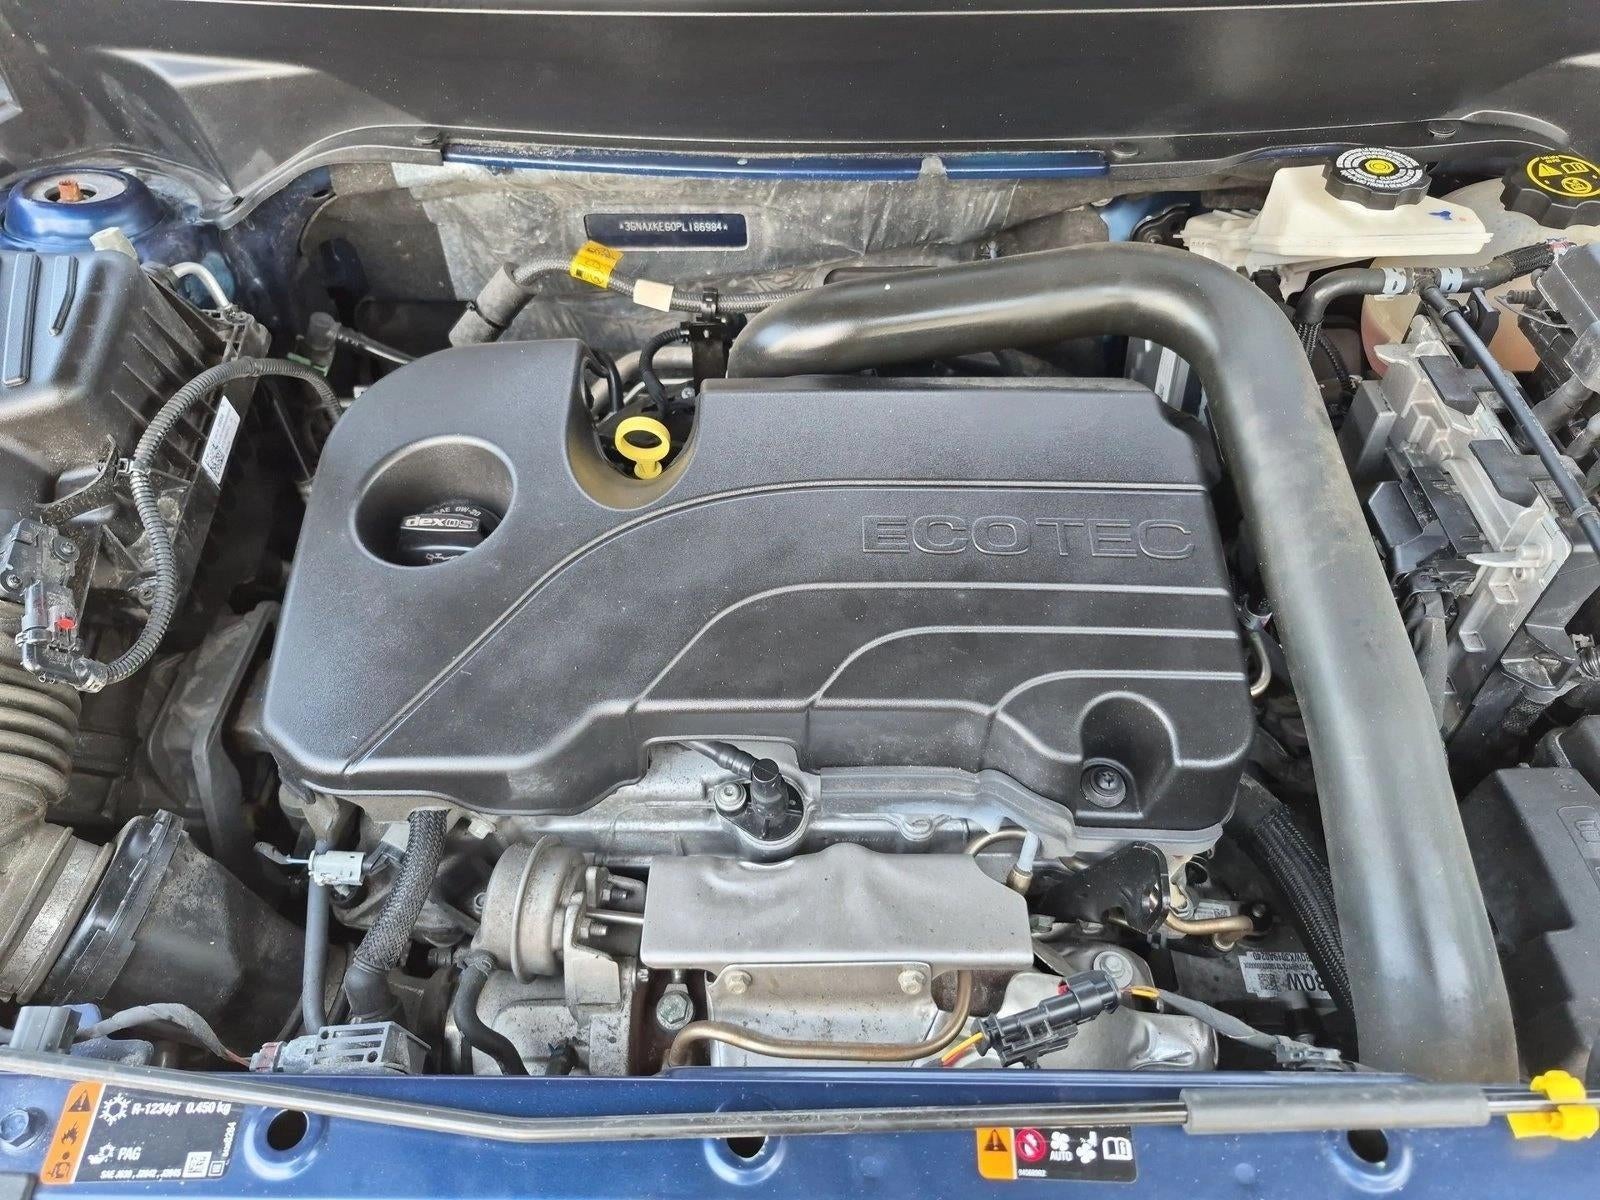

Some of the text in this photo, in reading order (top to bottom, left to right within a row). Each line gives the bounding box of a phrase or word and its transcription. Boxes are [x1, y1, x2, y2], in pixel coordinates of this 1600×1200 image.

[862, 514, 1194, 559] ECOTEC
[131, 1101, 232, 1117] R-1234yf 0.450 kg
[117, 1146, 142, 1161] PAG
[1050, 1150, 1074, 1161] AUTO
